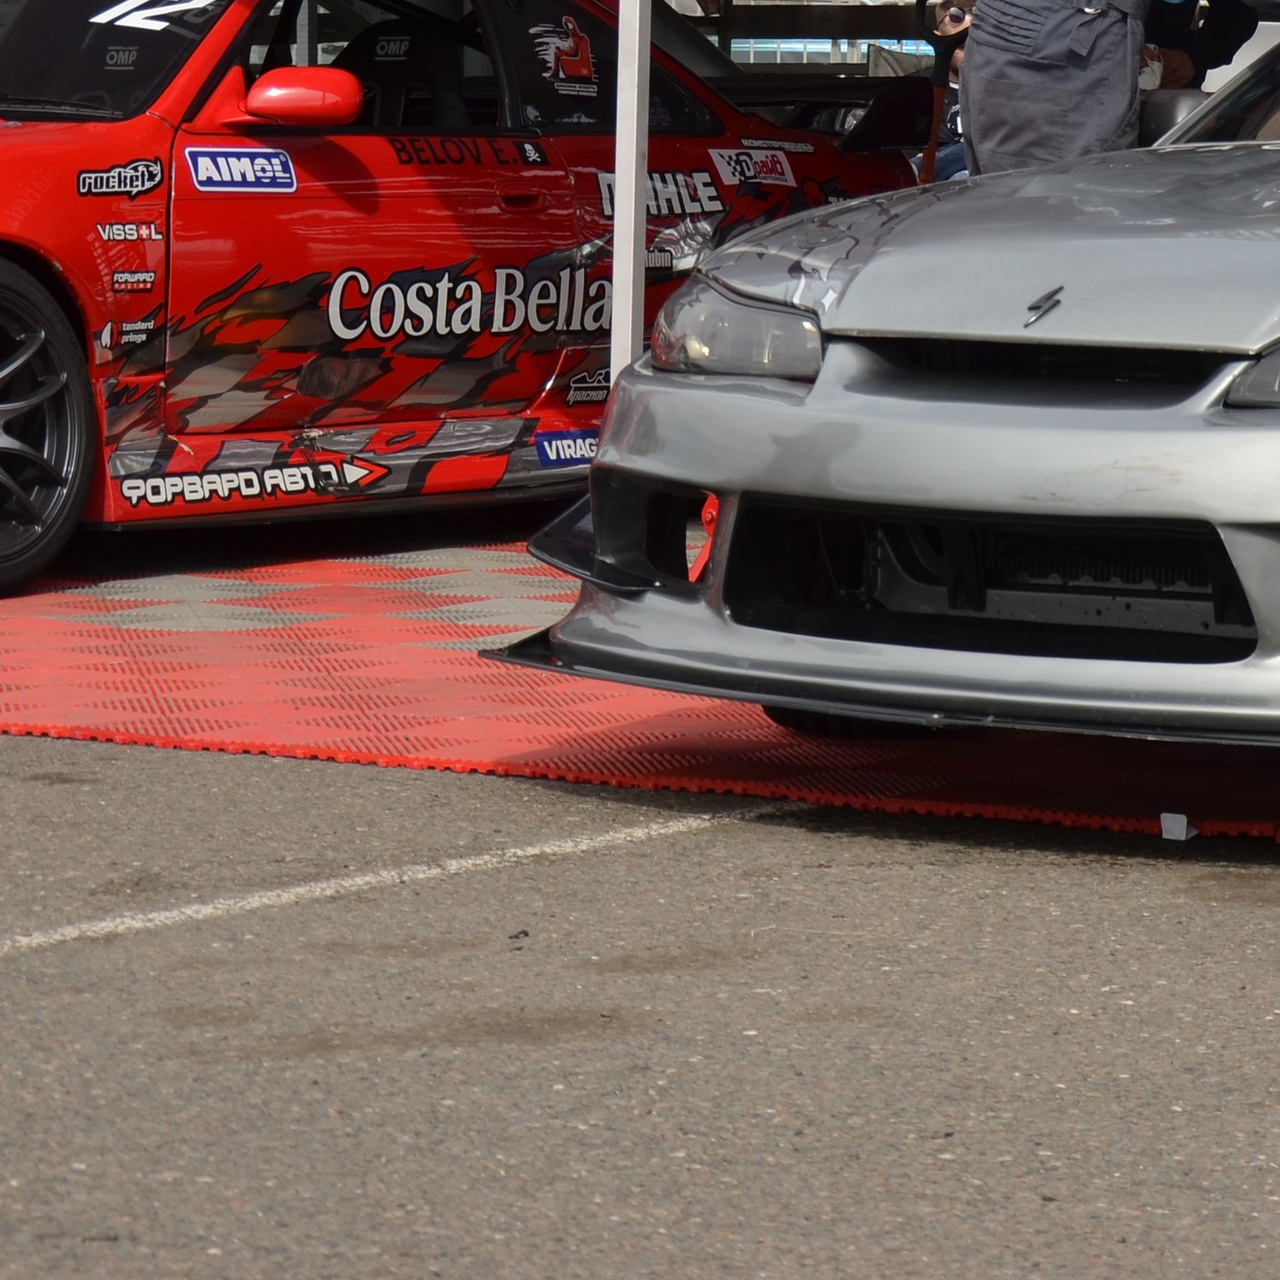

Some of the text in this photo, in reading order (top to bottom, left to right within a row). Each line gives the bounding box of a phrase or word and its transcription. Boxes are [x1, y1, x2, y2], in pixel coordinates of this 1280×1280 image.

[106, 51, 137, 65] OMP
[375, 40, 410, 56] OMP
[387, 138, 486, 166] BELOV
[79, 166, 149, 193] rocket
[197, 157, 292, 182] AIMOL
[113, 272, 155, 283] FORWARD
[329, 267, 613, 340] Costa Bella
[543, 437, 599, 461] VIRAG
[122, 471, 261, 505] ФОРВАРД
